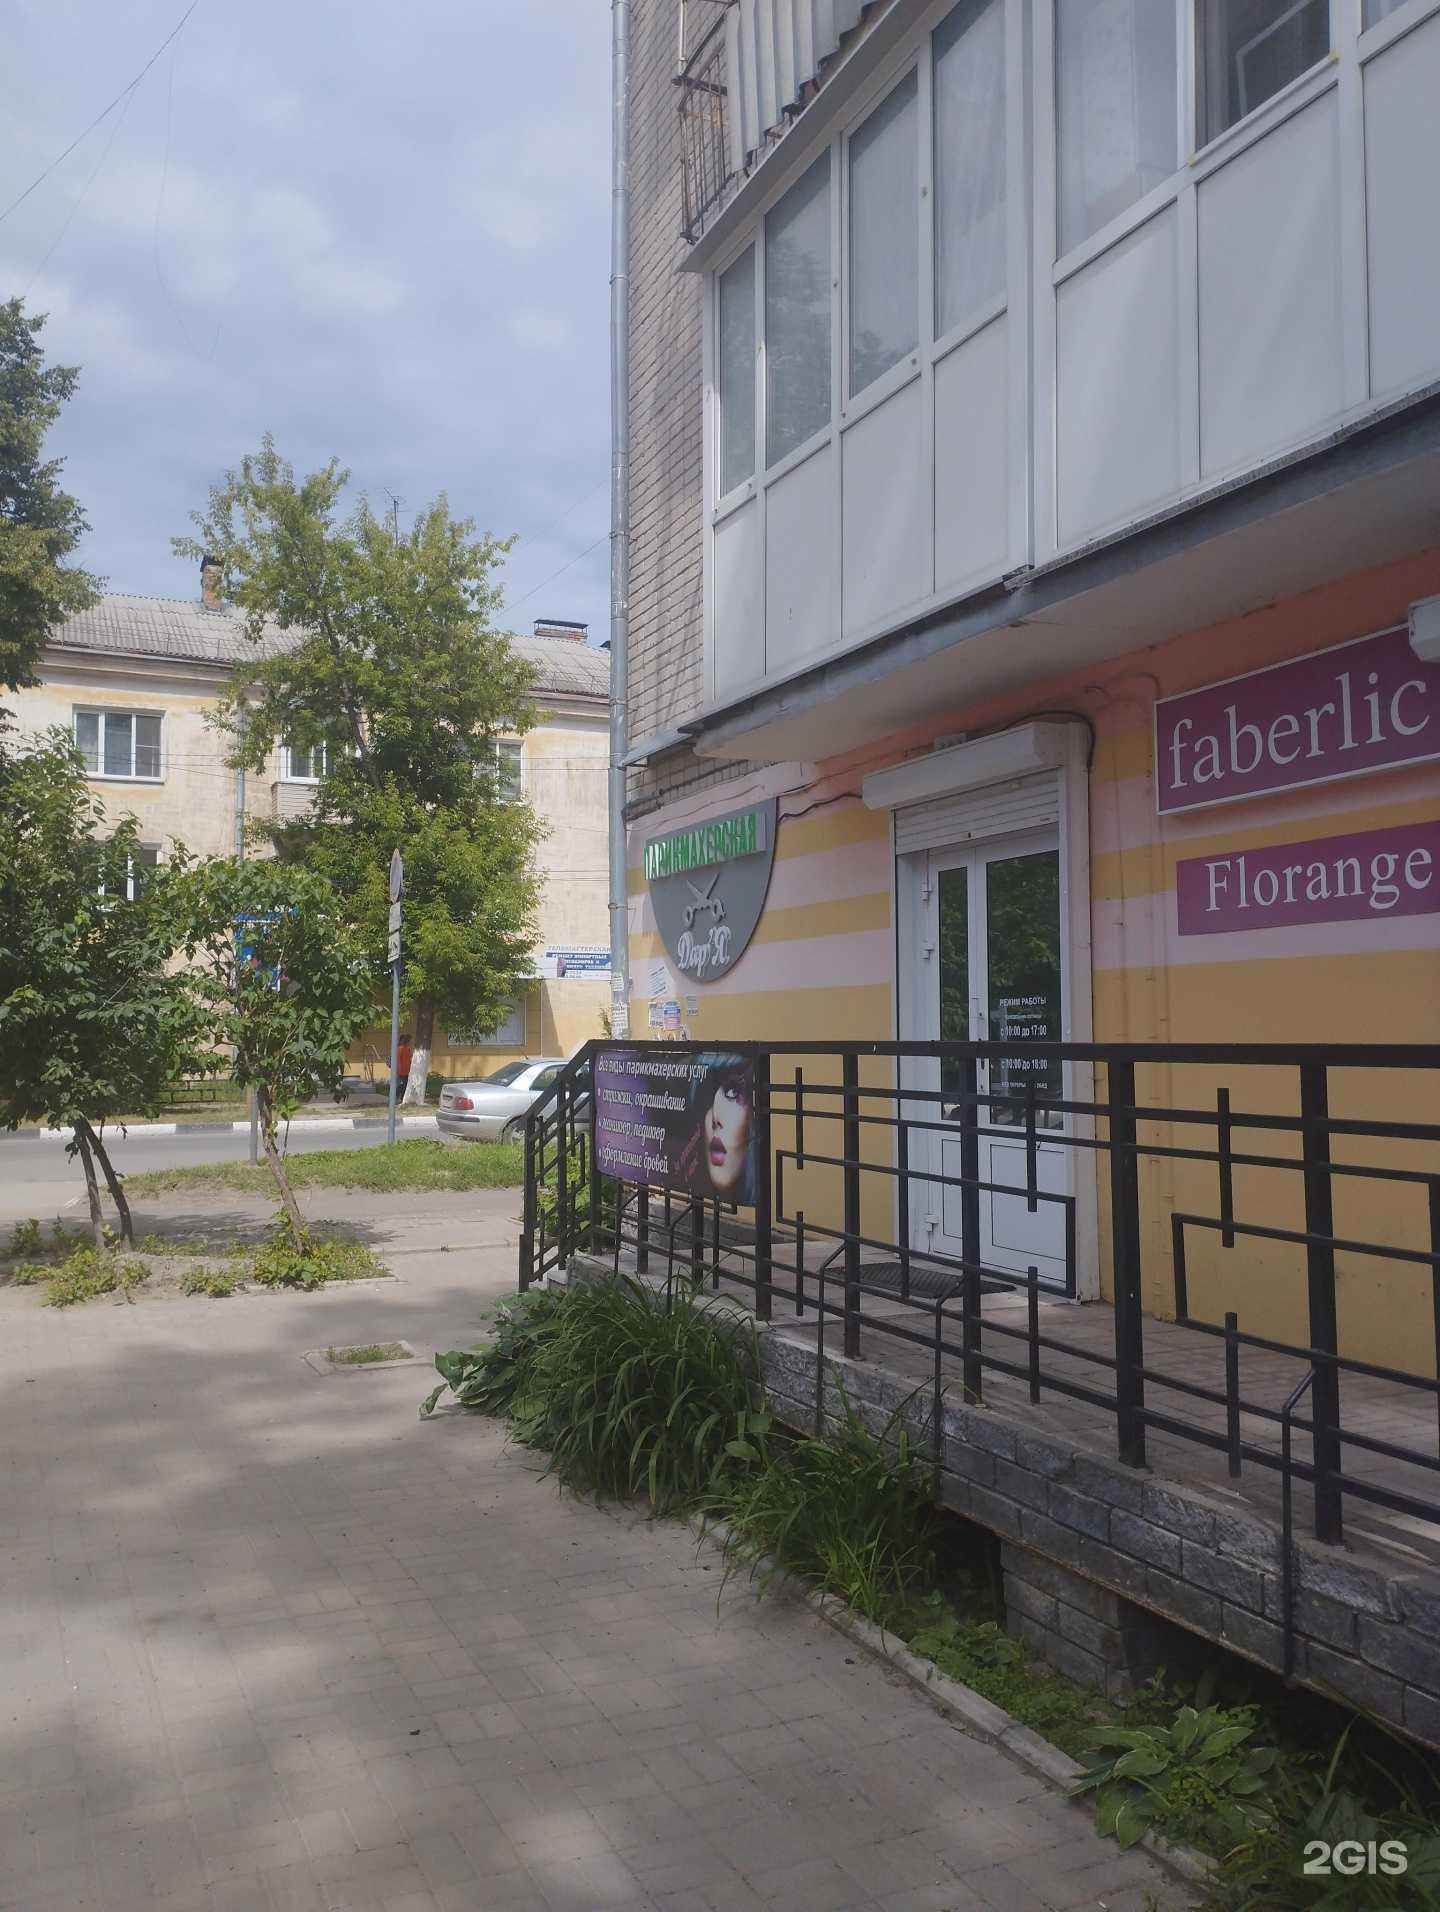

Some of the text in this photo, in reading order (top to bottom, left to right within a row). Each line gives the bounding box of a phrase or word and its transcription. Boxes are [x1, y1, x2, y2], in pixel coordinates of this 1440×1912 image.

[1168, 671, 1430, 790] faberlic
[1204, 848, 1433, 913] Florange
[999, 996, 1047, 1007] РЕЖИМ РАБОТЫ
[1021, 1028, 1030, 1037] до
[1031, 1025, 1047, 1036] 17:00
[598, 1056, 709, 1083] Все виды парикмахерских услуг
[1022, 1060, 1031, 1072] до
[1031, 1058, 1048, 1070] 18:00
[634, 1090, 686, 1114] окрашивание
[643, 1151, 669, 1178] бровей
